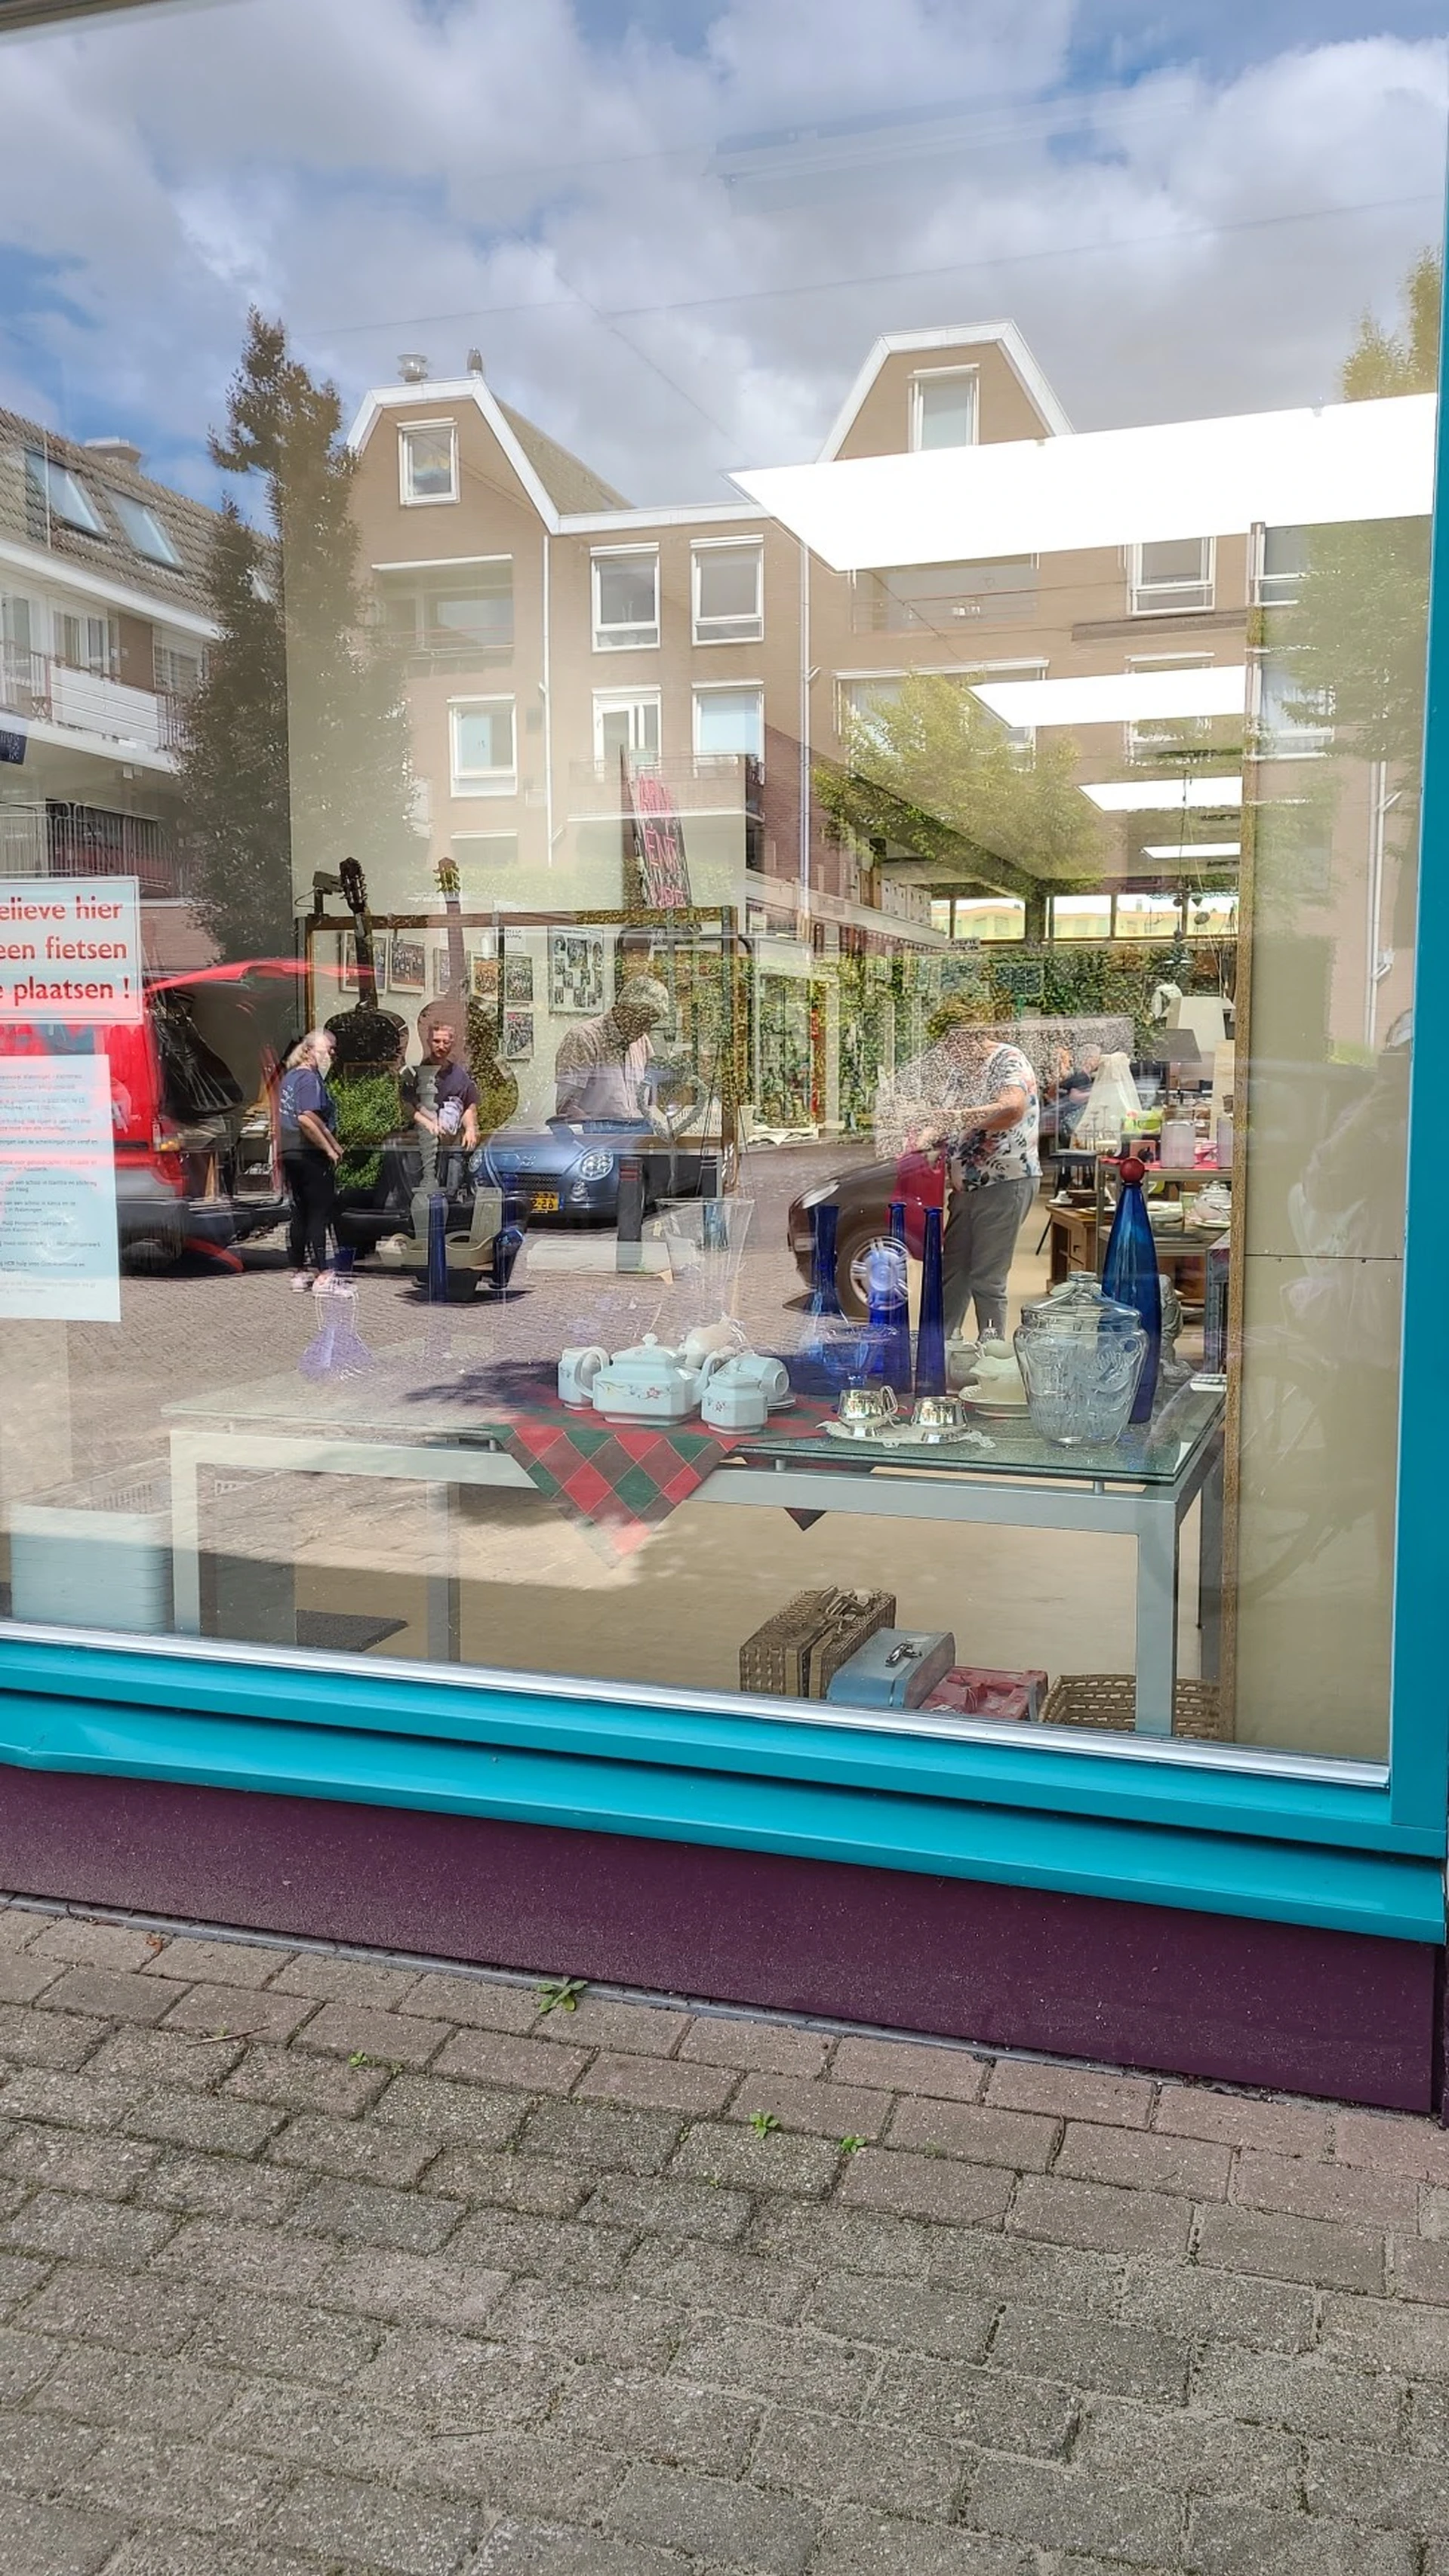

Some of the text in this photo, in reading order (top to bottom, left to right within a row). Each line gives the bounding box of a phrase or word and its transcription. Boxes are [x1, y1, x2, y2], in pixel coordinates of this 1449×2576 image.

[0, 896, 123, 920] elieve hier
[45, 936, 128, 959] fietsen
[14, 976, 113, 1006] plaatsen
[124, 977, 129, 999] !
